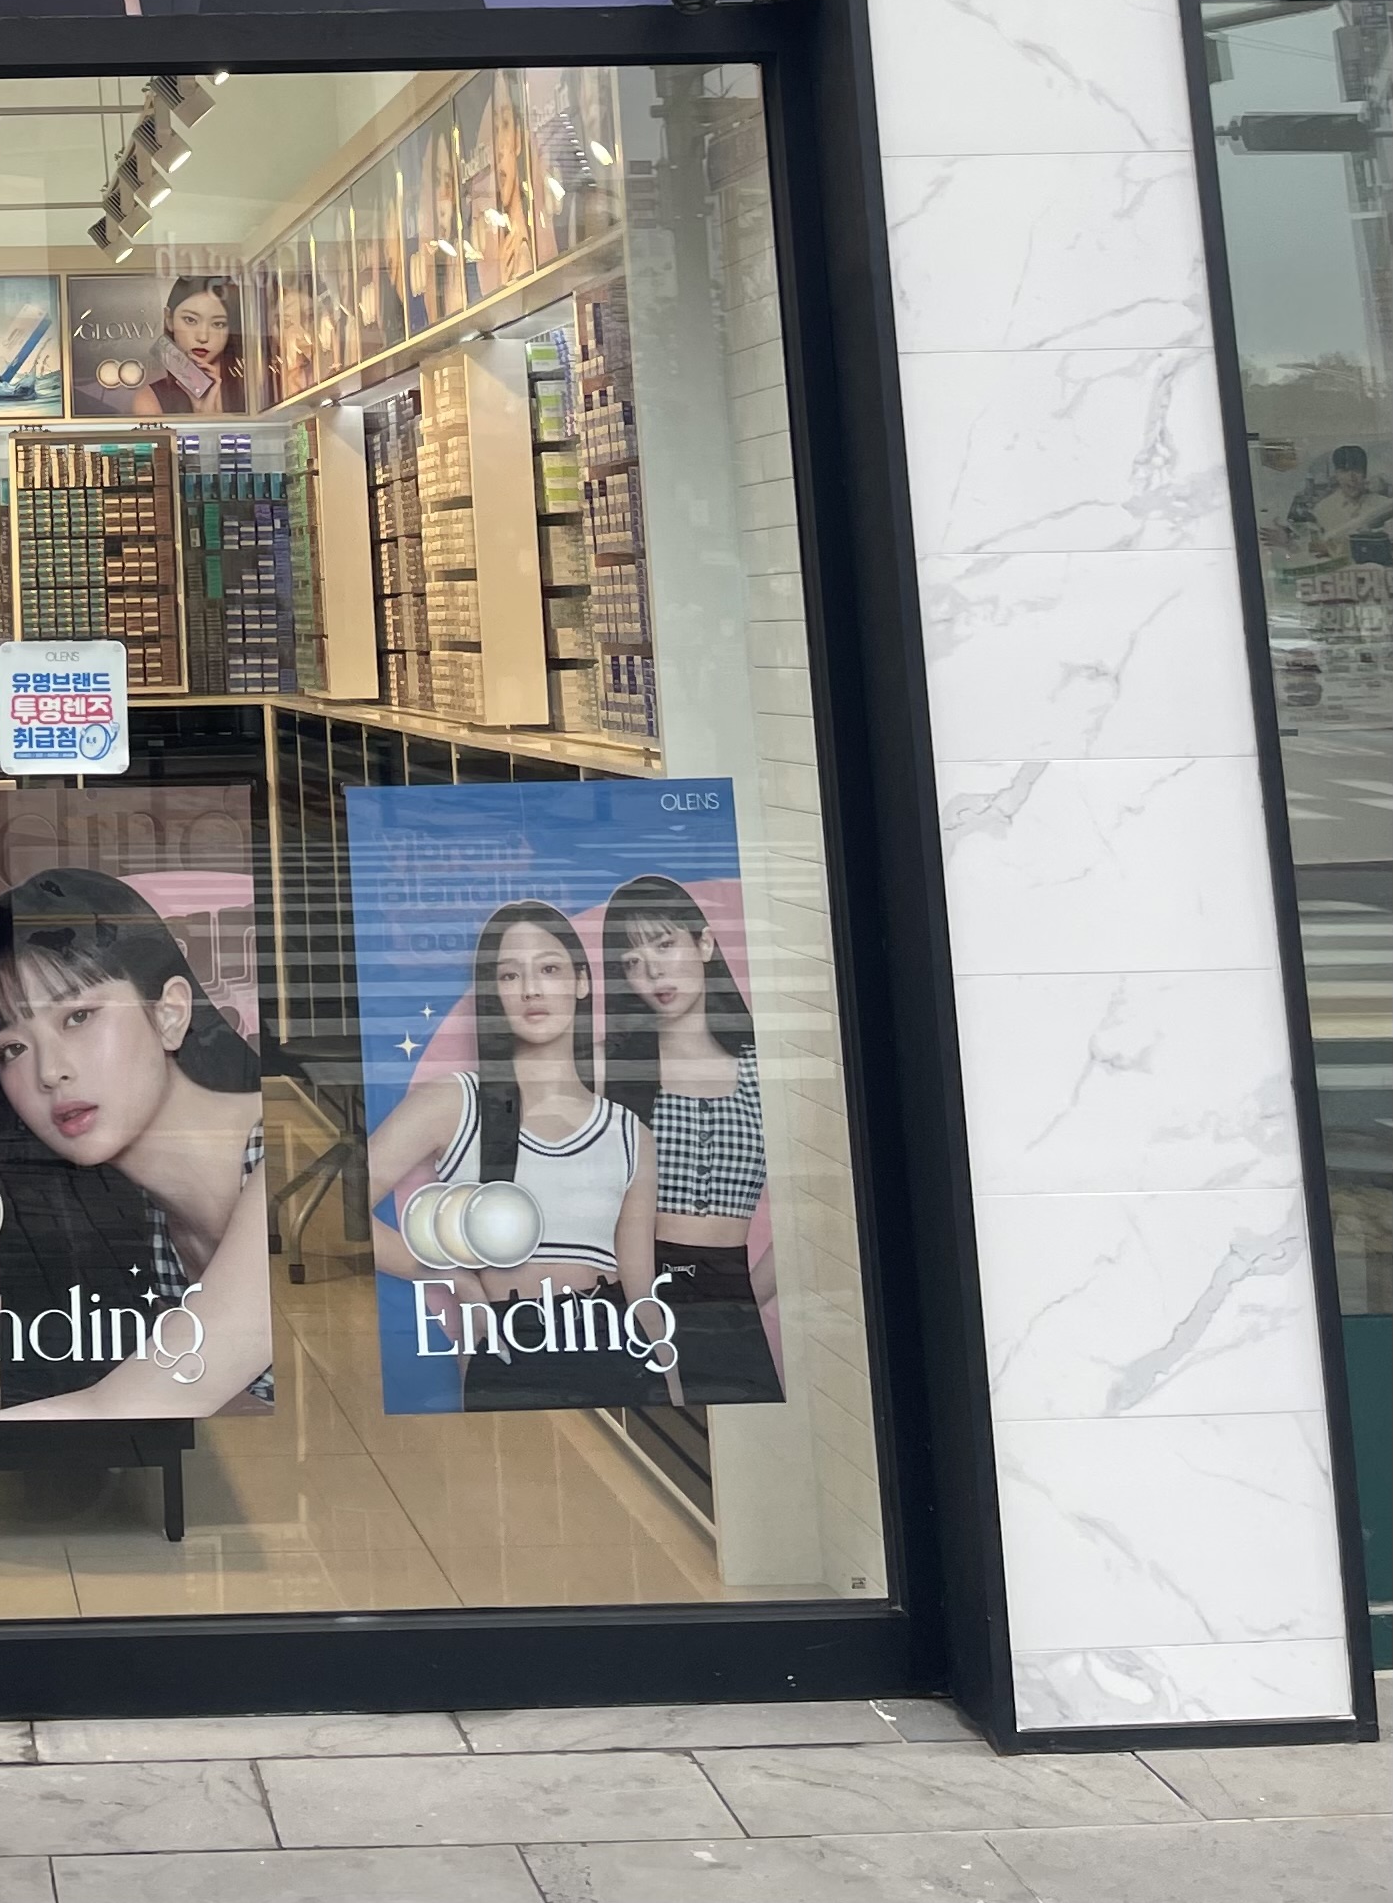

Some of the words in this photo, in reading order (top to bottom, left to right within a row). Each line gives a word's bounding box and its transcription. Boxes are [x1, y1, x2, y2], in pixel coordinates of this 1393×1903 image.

[45, 651, 80, 662] OLENS
[12, 672, 111, 693] 유명브랜드
[12, 695, 112, 724] 투명렌즈
[13, 726, 77, 749] 취급점
[660, 792, 720, 811] OLENS
[412, 1273, 678, 1373] Ending
